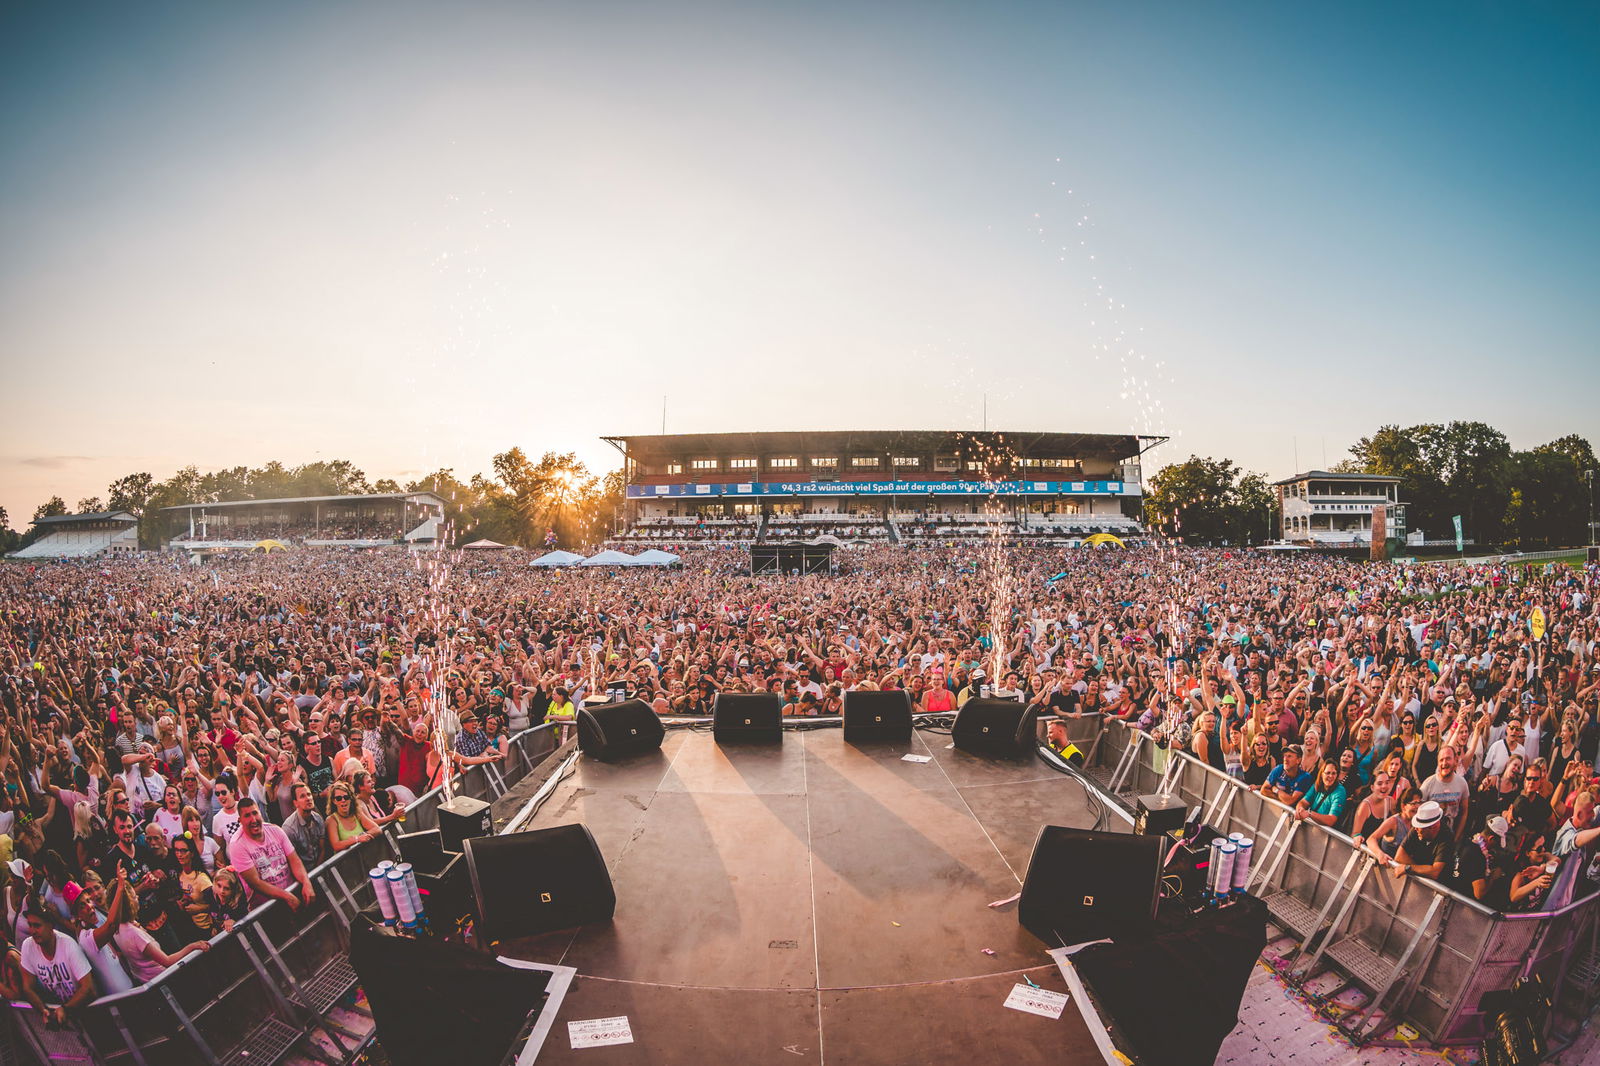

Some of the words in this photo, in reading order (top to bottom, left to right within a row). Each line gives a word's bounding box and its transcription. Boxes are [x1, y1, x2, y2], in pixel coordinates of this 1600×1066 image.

[781, 483, 801, 492] 94,3
[803, 483, 817, 491] rs2
[818, 483, 854, 491] wünscht
[855, 483, 871, 491] viel
[873, 483, 894, 493] Spaß
[895, 482, 910, 490] auf
[911, 482, 925, 490] der
[927, 482, 957, 492] großen
[959, 482, 978, 491] 90er
[38, 964, 48, 982] SEE
[46, 962, 70, 982] YOU
